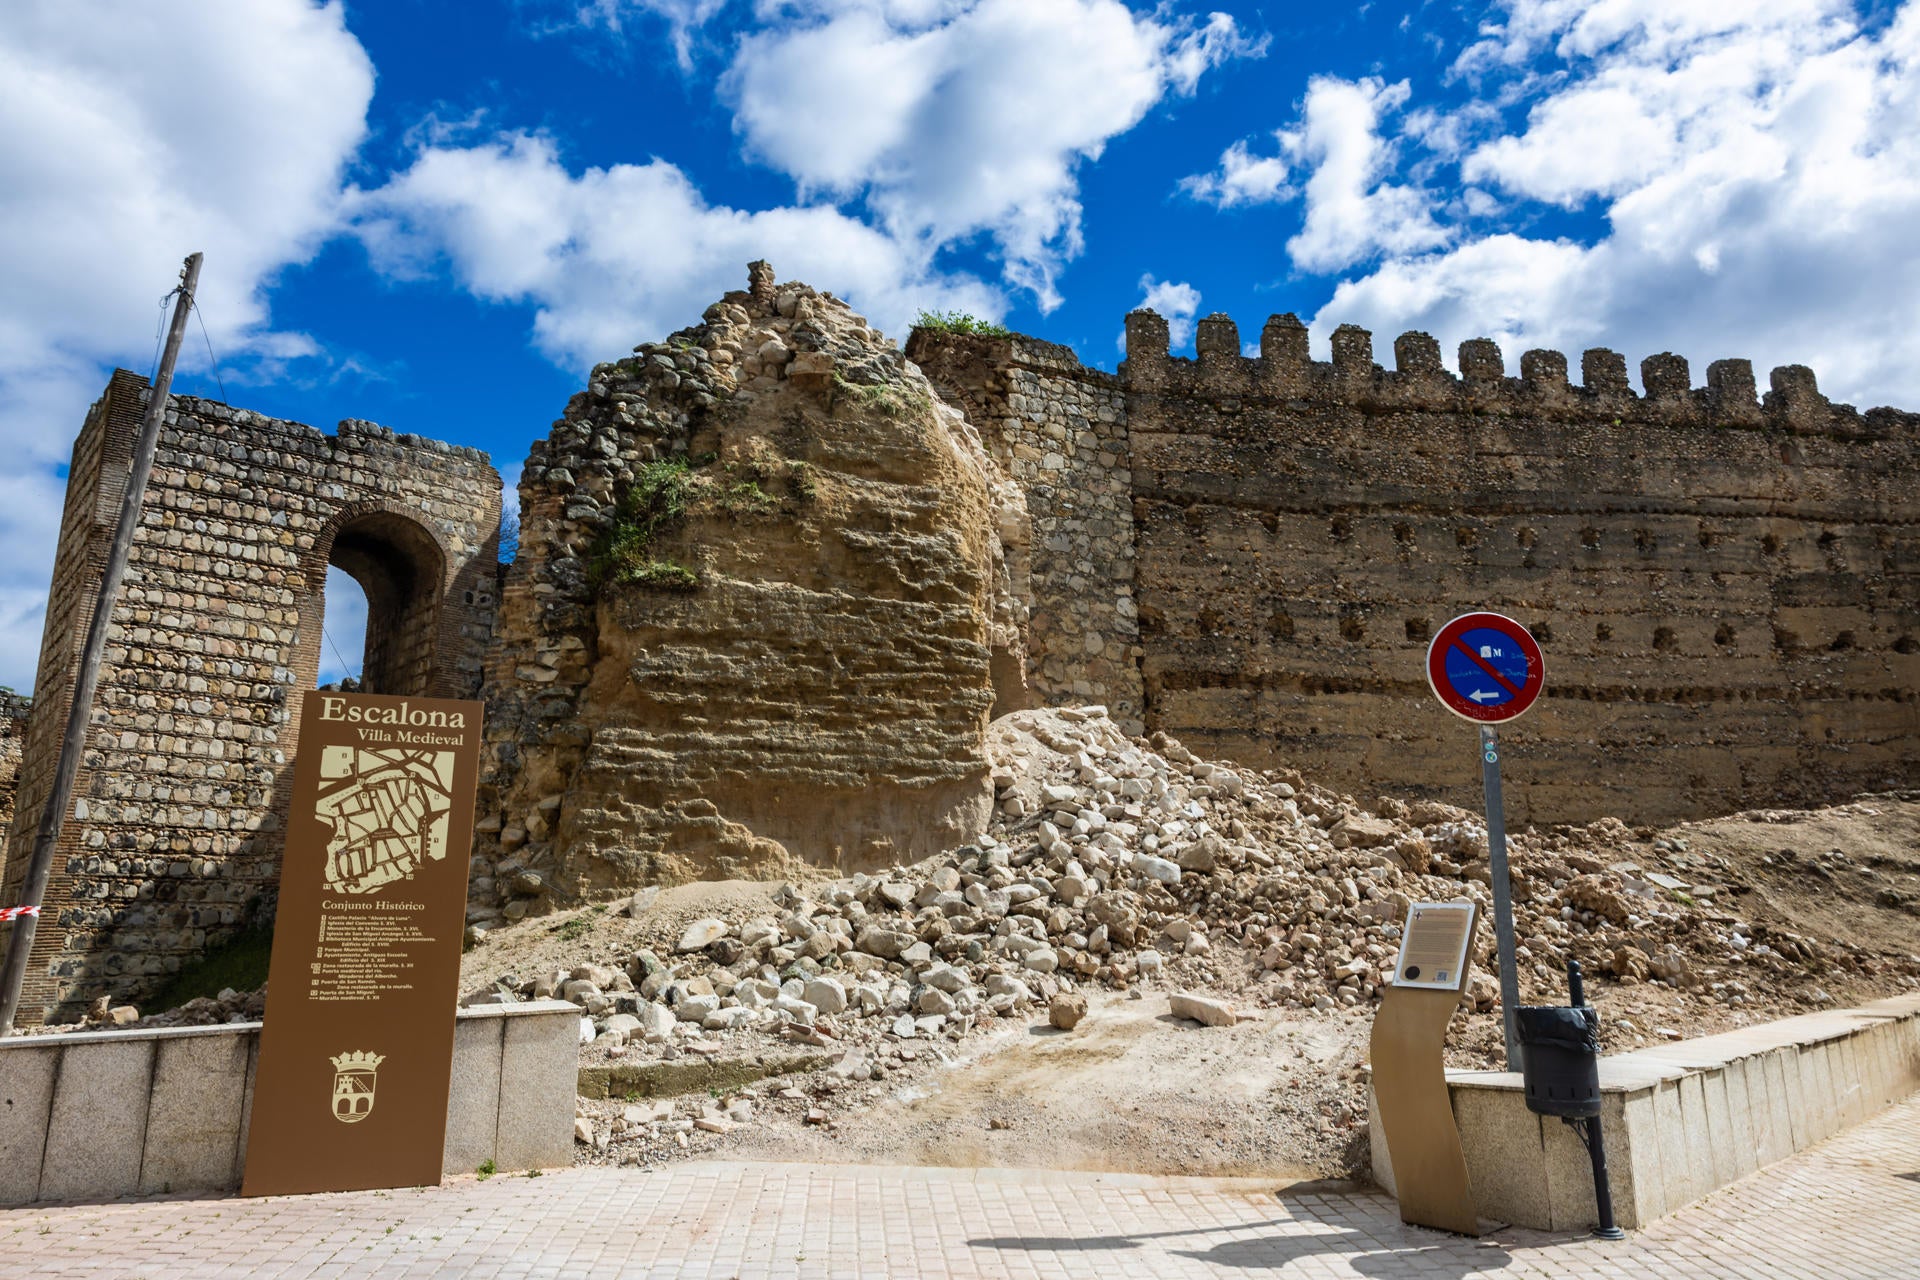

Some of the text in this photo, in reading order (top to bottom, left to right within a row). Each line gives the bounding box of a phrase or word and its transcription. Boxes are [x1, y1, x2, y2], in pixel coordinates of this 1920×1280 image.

[319, 696, 466, 728] Escalona
[357, 728, 464, 746] Villa Medieval
[322, 900, 425, 912] Conjunto Histórico
